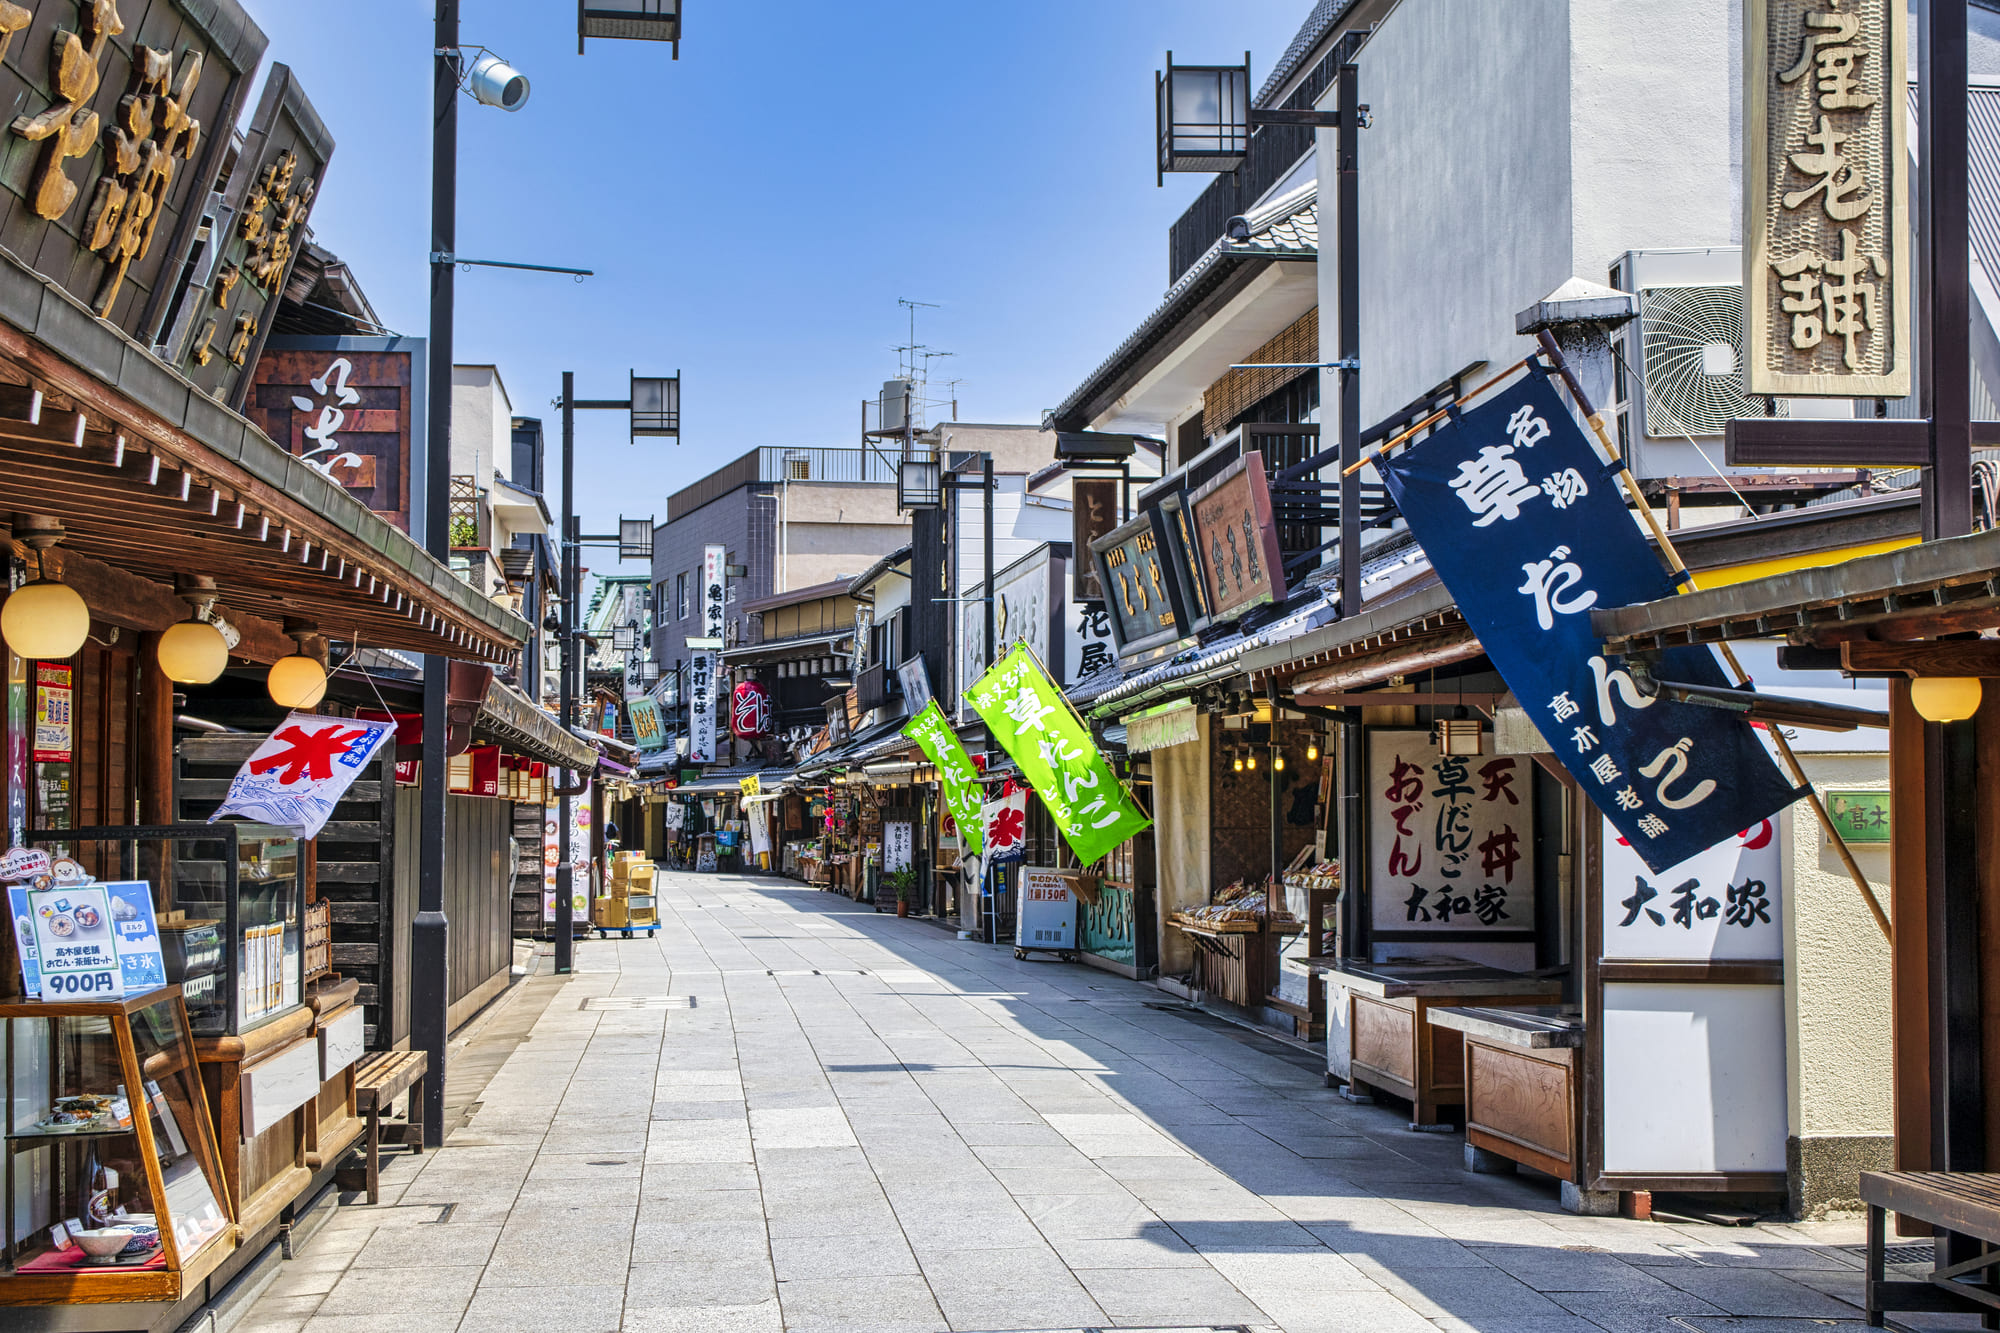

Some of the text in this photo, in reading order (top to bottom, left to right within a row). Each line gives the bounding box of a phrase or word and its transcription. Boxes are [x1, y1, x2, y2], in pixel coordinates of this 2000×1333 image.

[1507, 404, 1588, 509] 名物
[1448, 444, 1716, 809] 草だんご
[693, 656, 707, 714] 手打そば
[976, 660, 1030, 709] 柴又名物
[1002, 687, 1121, 829] 草だんご
[947, 795, 974, 834] とらや
[1043, 785, 1083, 837] とらや
[1385, 754, 1424, 877] おでん
[1432, 757, 1475, 878] 草だんご
[1478, 758, 1521, 885] 天丼
[125, 924, 143, 932] ミルク
[1404, 882, 1510, 925] 大和家
[1618, 875, 1771, 929] 大和家
[50, 972, 113, 994] 900円
[120, 953, 155, 970] き氷
